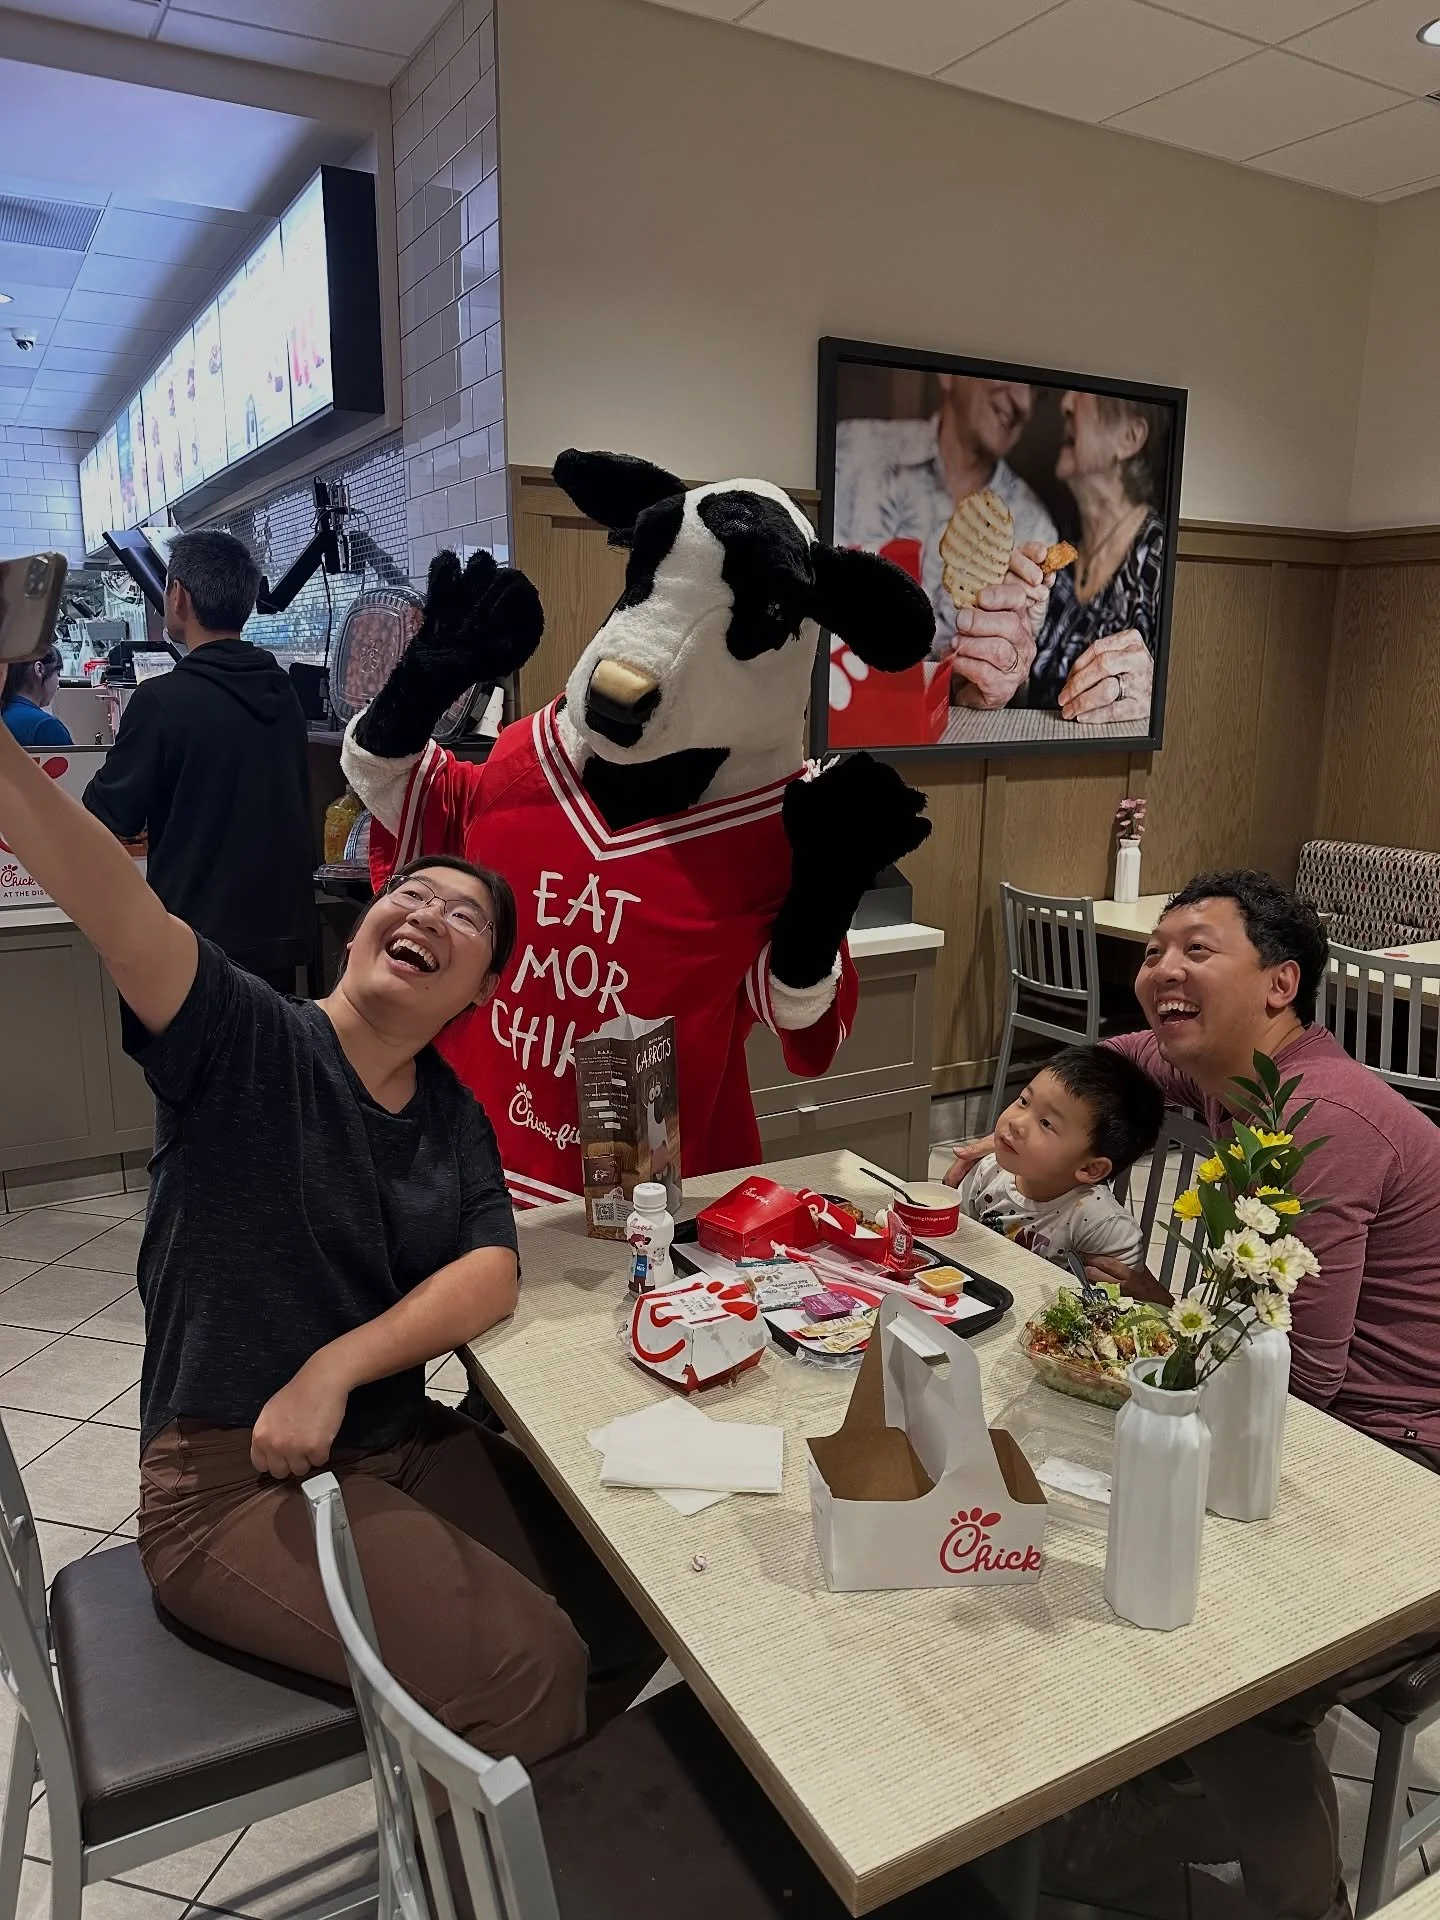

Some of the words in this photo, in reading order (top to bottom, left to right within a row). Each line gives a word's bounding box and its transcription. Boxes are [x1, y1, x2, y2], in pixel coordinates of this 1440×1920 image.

[0, 868, 36, 887] Chick
[532, 870, 642, 945] EAT
[510, 944, 629, 1016] MOR
[940, 1522, 1041, 1574] Chick
